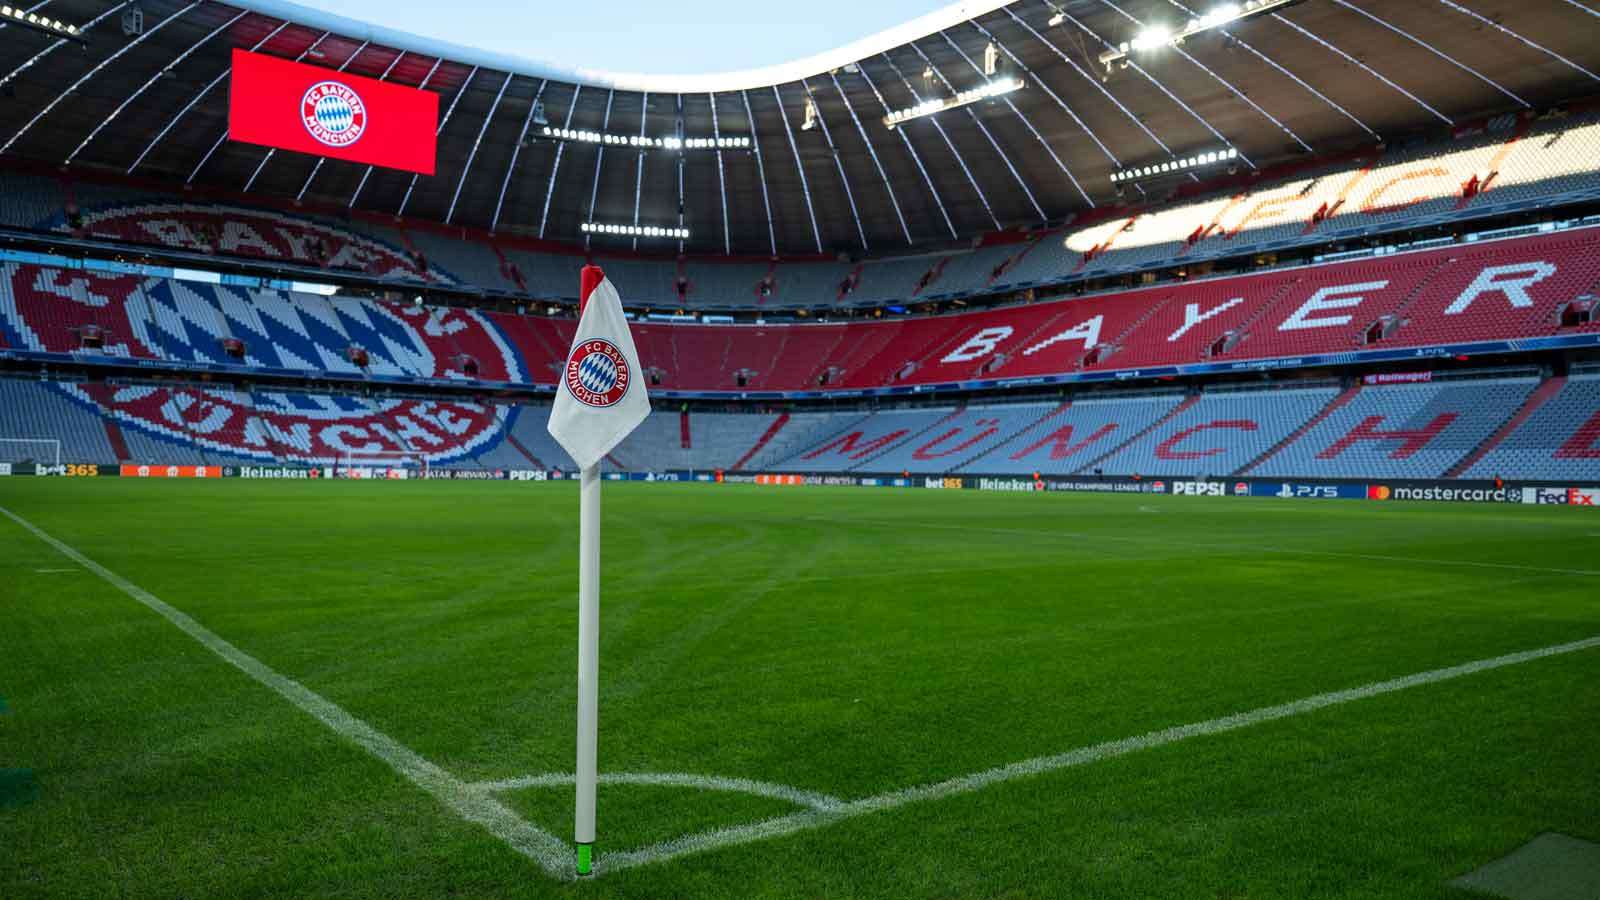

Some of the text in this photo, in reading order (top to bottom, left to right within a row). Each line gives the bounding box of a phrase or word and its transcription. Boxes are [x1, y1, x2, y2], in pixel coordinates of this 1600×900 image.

[307, 86, 361, 114] FC BAYERN
[585, 342, 626, 390] FC BAYERN
[240, 466, 307, 479] Heineken
[510, 470, 547, 481] PEPSI
[926, 477, 962, 488] bet365
[980, 478, 1034, 491] Heineken
[1173, 481, 1225, 496] PEPSI
[1297, 486, 1338, 498] PS5
[1394, 486, 1506, 501] mastercard
[1536, 487, 1593, 506] FedEx
